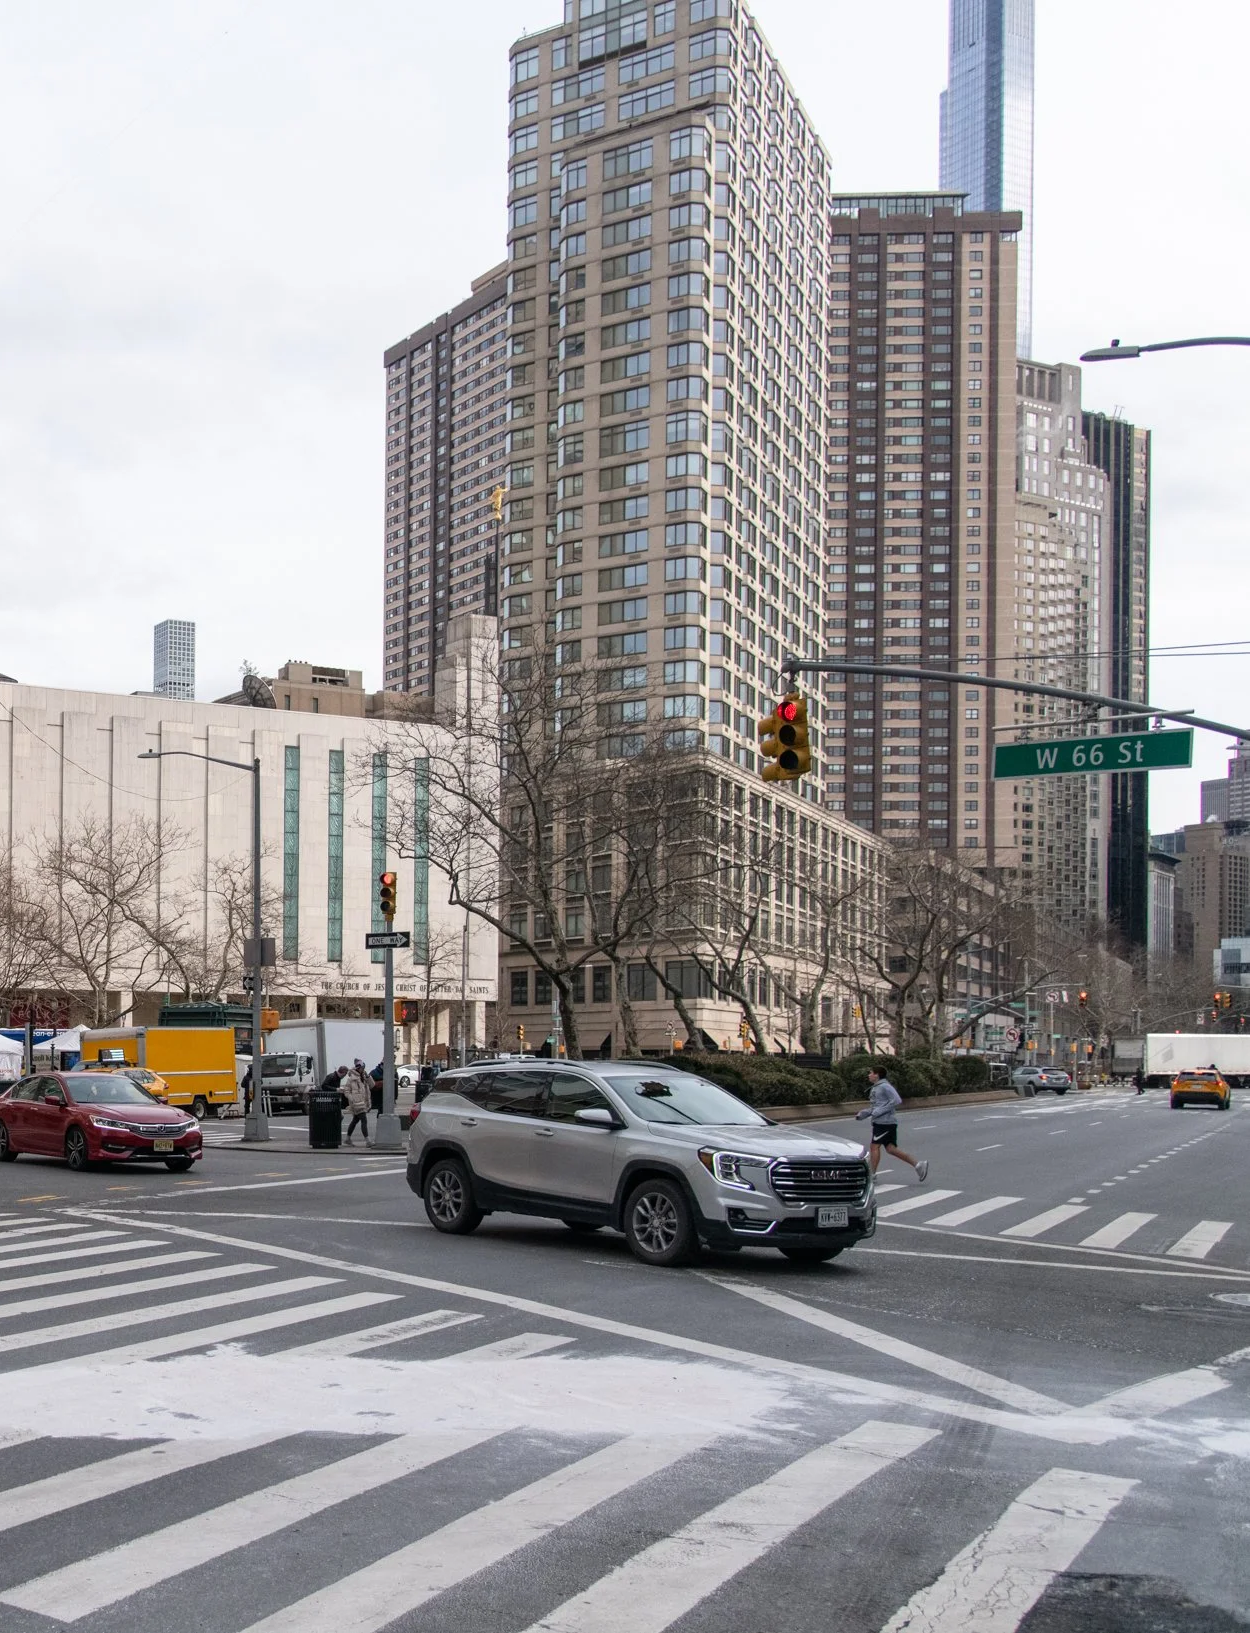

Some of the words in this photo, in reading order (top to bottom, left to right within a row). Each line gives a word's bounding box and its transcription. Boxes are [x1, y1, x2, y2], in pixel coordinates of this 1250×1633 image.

[1036, 747, 1058, 769] W
[1072, 744, 1104, 767] 66
[1118, 740, 1144, 764] St
[390, 936, 403, 944] WAY
[321, 981, 332, 990] THE
[336, 982, 359, 991] CHURCH
[363, 983, 370, 991] OF
[374, 983, 385, 991] JES
[395, 984, 416, 992] CHRIST
[431, 985, 462, 994] LATTER-DA
[470, 986, 489, 994] SAINTS
[811, 1170, 848, 1180] GMC
